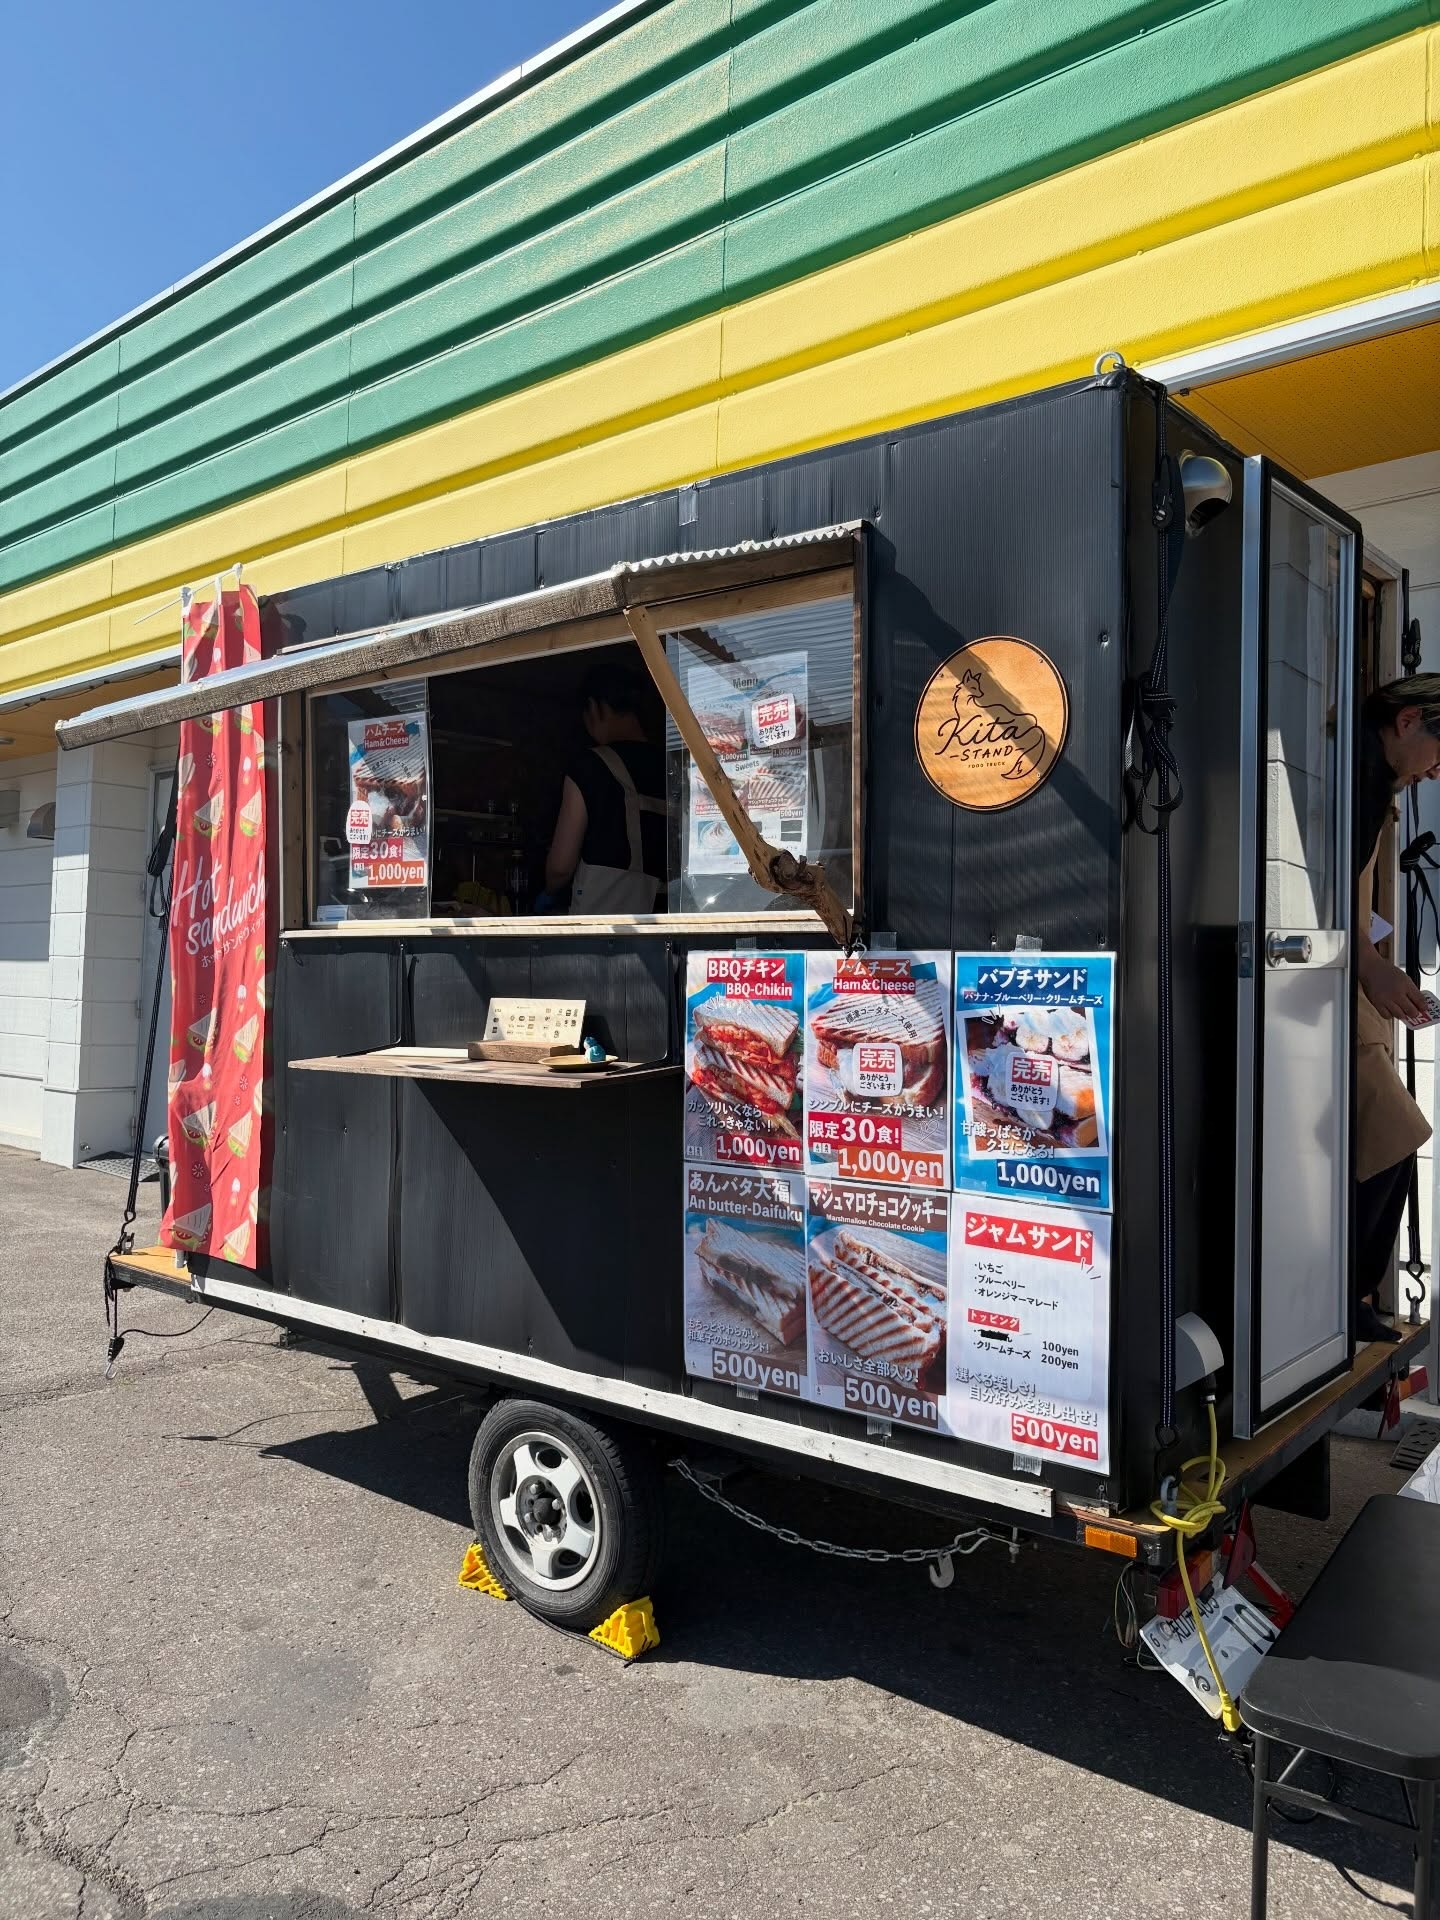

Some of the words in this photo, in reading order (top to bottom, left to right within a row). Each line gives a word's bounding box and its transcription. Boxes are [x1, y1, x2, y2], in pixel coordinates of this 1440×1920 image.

[758, 699, 788, 724] 完売
[759, 723, 784, 736] ありがとう
[935, 714, 1025, 755] Kita
[364, 737, 409, 748] Ham&Cheese
[960, 745, 1014, 762] STAND
[735, 760, 760, 771] Sweets
[352, 841, 402, 859] 限定30食!
[368, 863, 424, 884] 1,000yen
[172, 855, 222, 927] Hot
[185, 850, 266, 955] sandwich
[708, 959, 785, 981] BBQチキン
[978, 967, 1087, 990] バブチサンド
[726, 982, 792, 998] BBQ-Chikin
[833, 978, 915, 991] Ham&Cheese
[861, 1049, 895, 1070] 完売
[860, 1073, 889, 1082] ありがとう
[1013, 1058, 1051, 1083] 完売
[860, 1083, 896, 1091] ございます!
[1010, 1084, 1043, 1095] ありがとう
[809, 1099, 945, 1119] シンプルにチーズがうまい!
[1010, 1093, 1050, 1106] ございます!
[809, 1117, 899, 1144] 限定30食!
[961, 1120, 1036, 1141] 甘酸っぱさが
[716, 1135, 800, 1163] 1,000yen
[986, 1139, 1055, 1159] クセになる!
[839, 1148, 943, 1181] 1,000yen
[689, 1171, 790, 1204] あんバタ大福
[997, 1161, 1100, 1194] 1,000yen
[689, 1194, 706, 1210] An
[708, 1196, 803, 1223] butter-Daifuku
[810, 1187, 947, 1224] マシュマロチョコクッキー
[826, 1213, 867, 1226] Marshmallow
[868, 1220, 901, 1230] Chocolate
[902, 1223, 925, 1233] Cookie
[966, 1216, 1093, 1257] ジャムサンド
[970, 1309, 1018, 1329] トッピング
[1041, 1340, 1079, 1357] 100yen
[713, 1350, 799, 1390] 500yen
[818, 1349, 919, 1383] おいしさ全部入り!
[1040, 1353, 1079, 1370] 200yen
[845, 1377, 937, 1421] 500yen
[1012, 1415, 1098, 1454] 500yen
